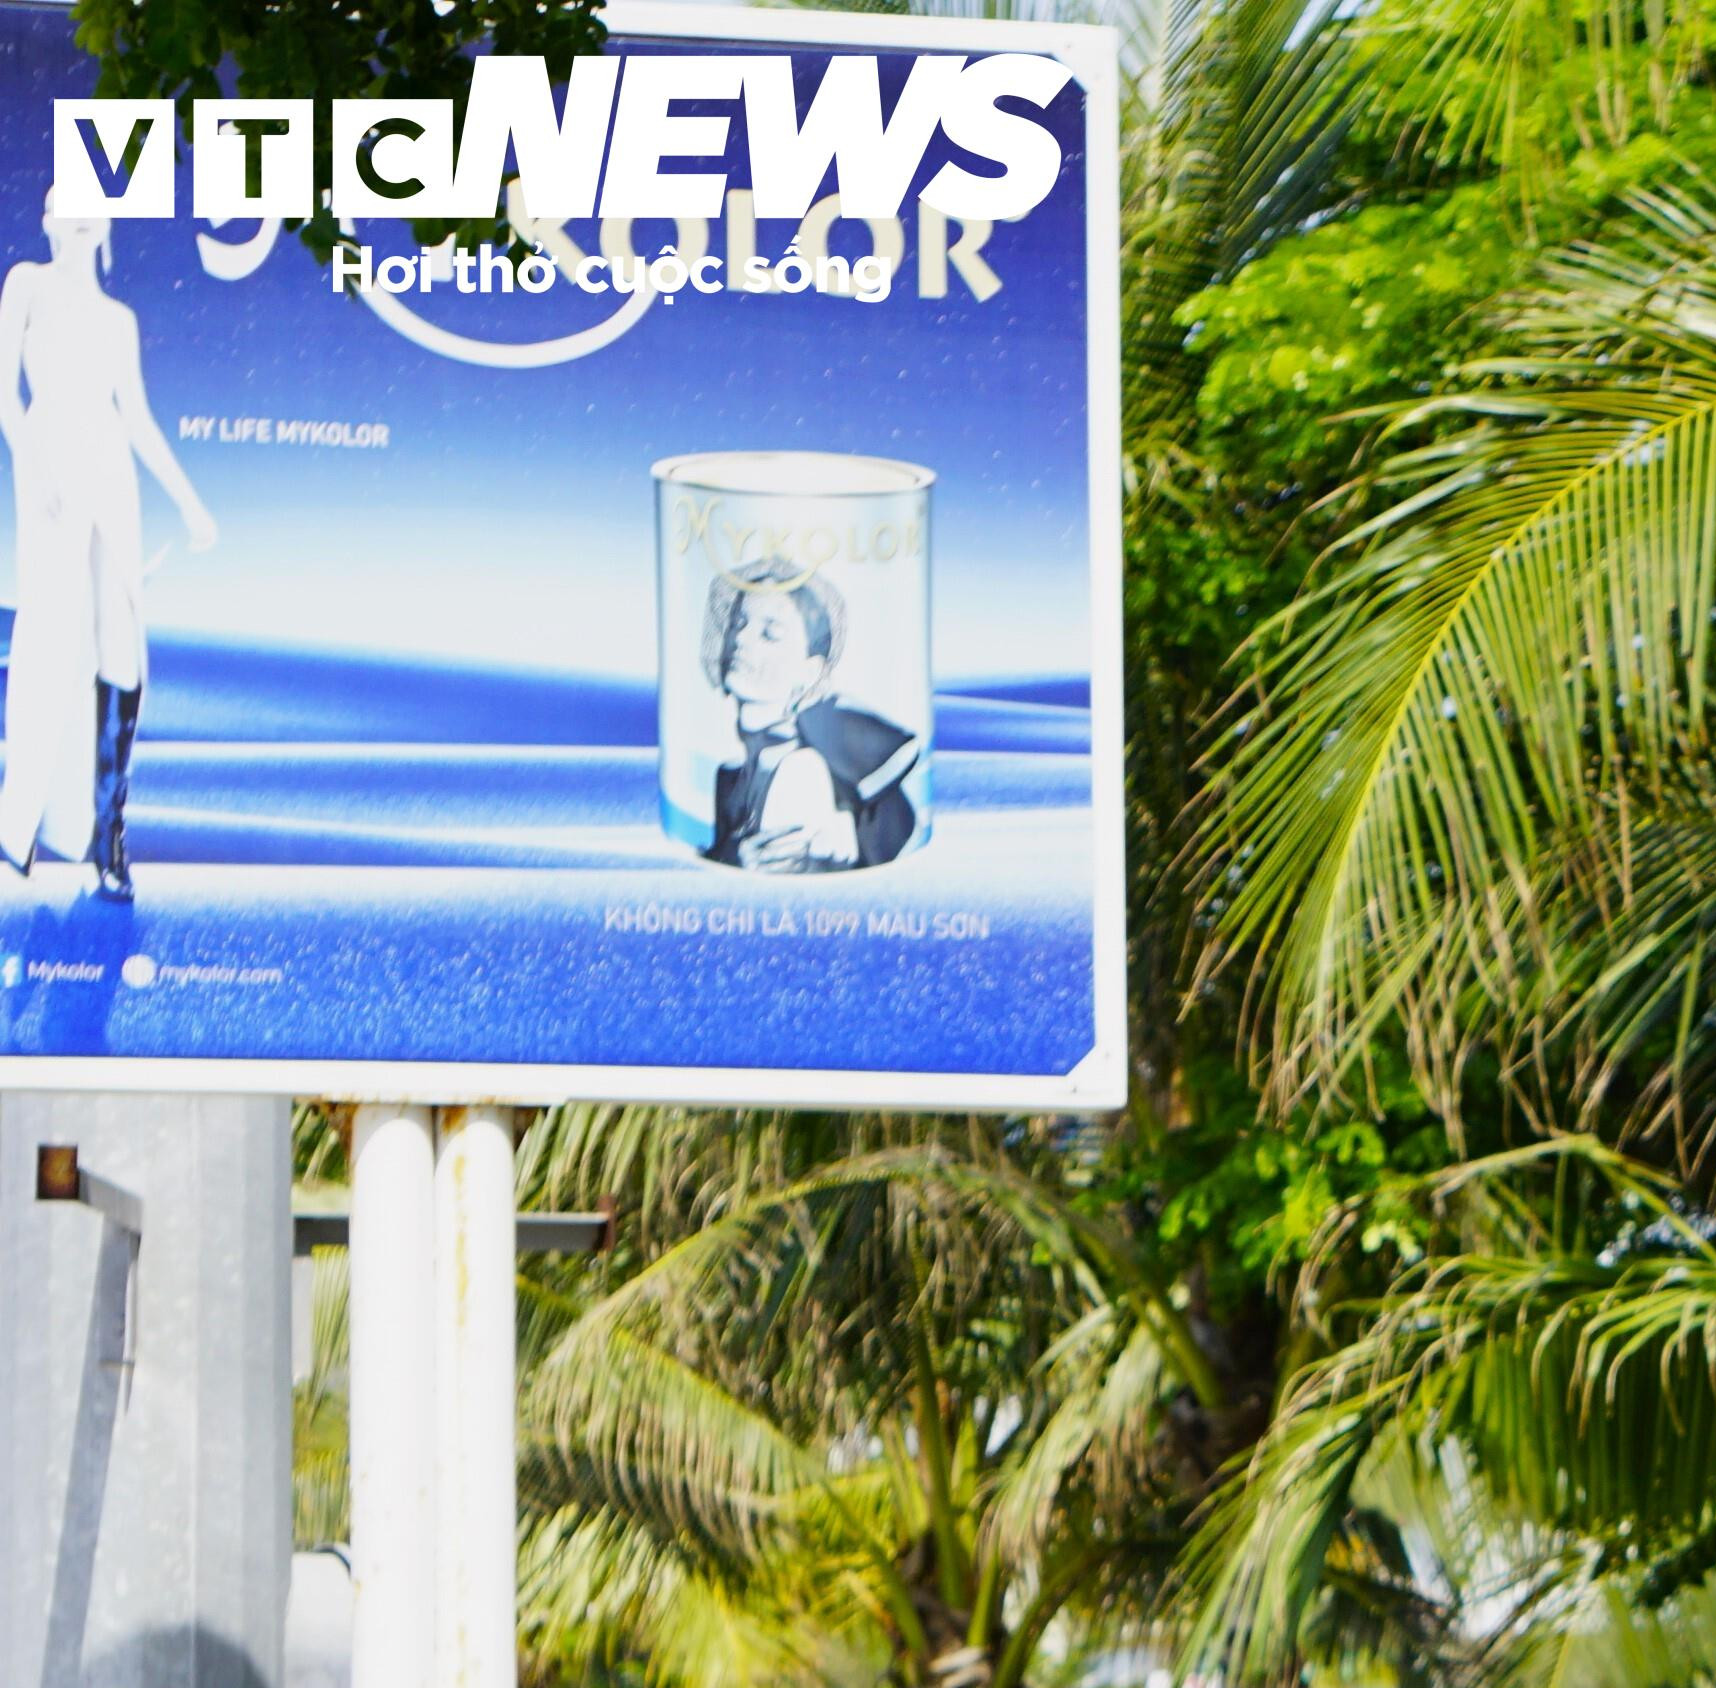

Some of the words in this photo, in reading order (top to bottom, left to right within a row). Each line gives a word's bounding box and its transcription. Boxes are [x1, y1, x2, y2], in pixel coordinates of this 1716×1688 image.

[179, 416, 214, 440] MY
[219, 418, 272, 443] LIFE
[276, 420, 391, 449] MYKOLOR
